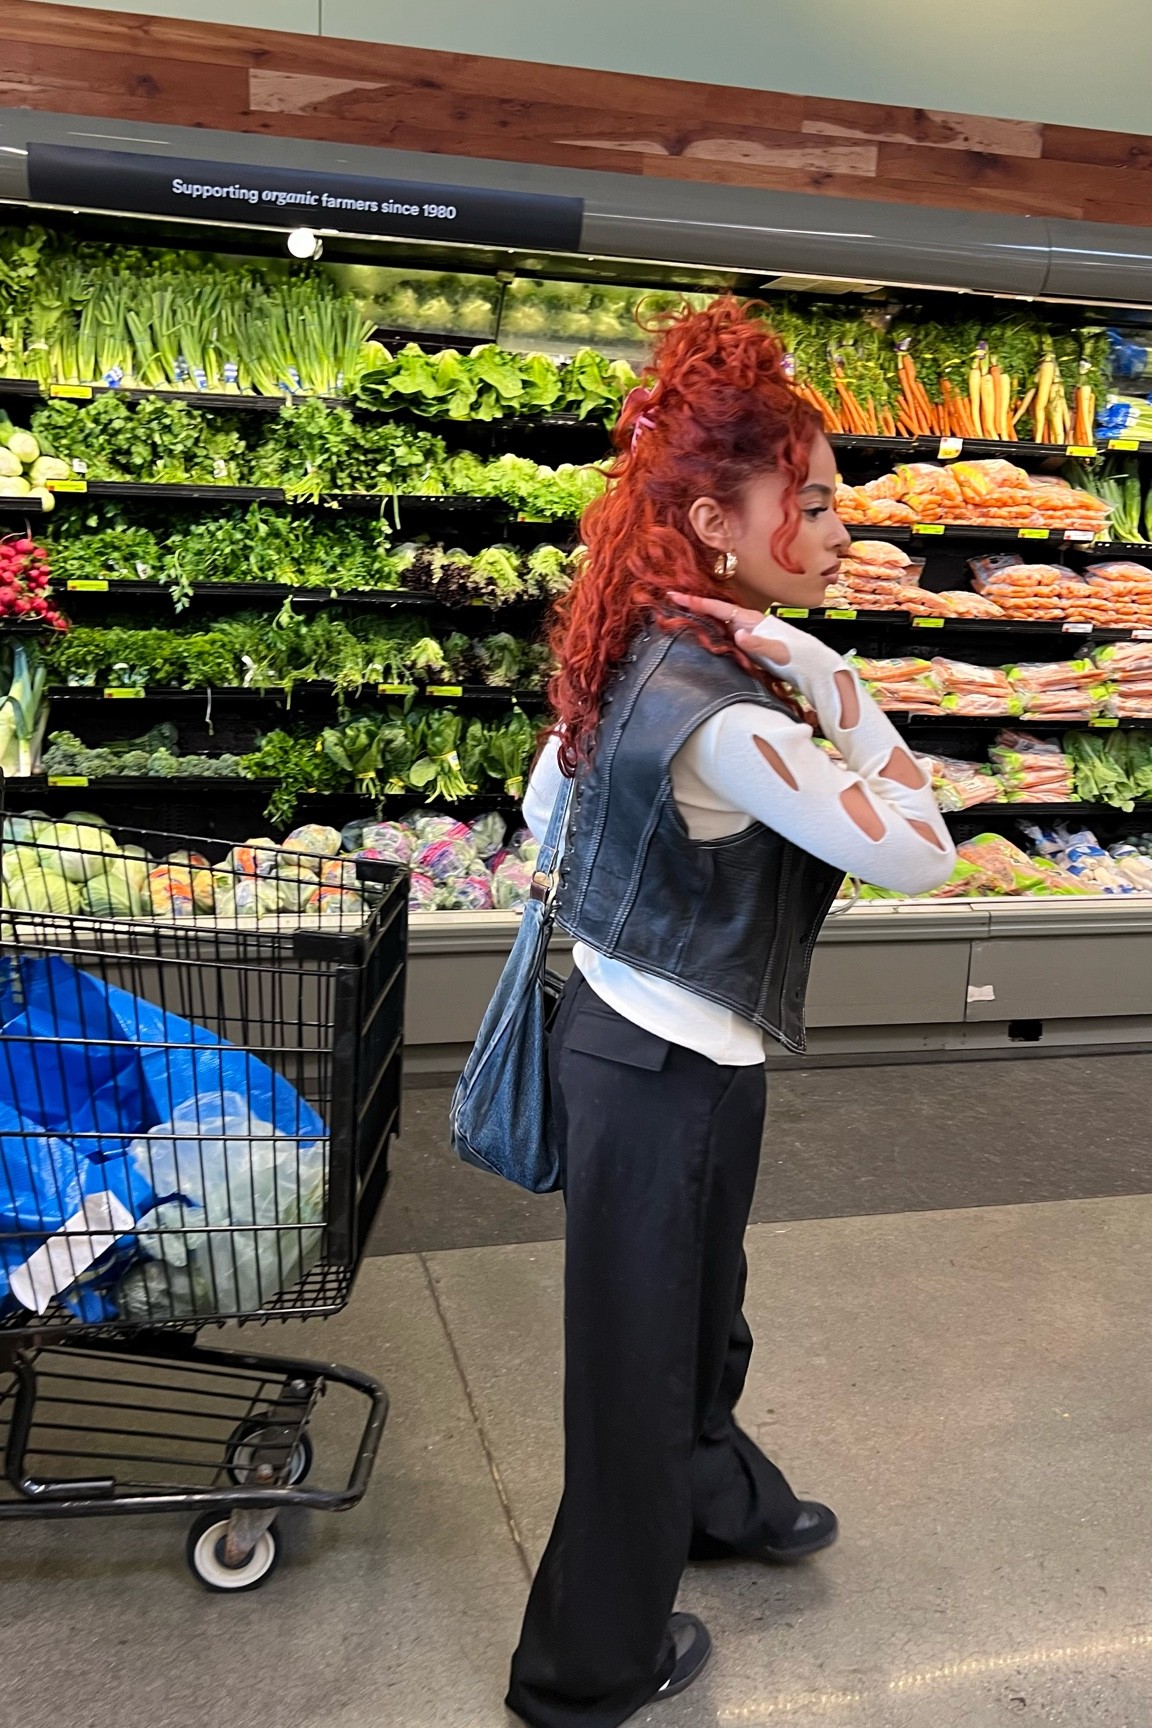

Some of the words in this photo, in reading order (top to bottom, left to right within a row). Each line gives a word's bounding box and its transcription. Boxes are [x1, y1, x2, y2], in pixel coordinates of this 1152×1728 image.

[172, 178, 259, 204] Supporting
[261, 190, 319, 206] organic
[321, 193, 378, 212] farmers
[381, 199, 420, 216] since
[422, 204, 457, 219] 1980
